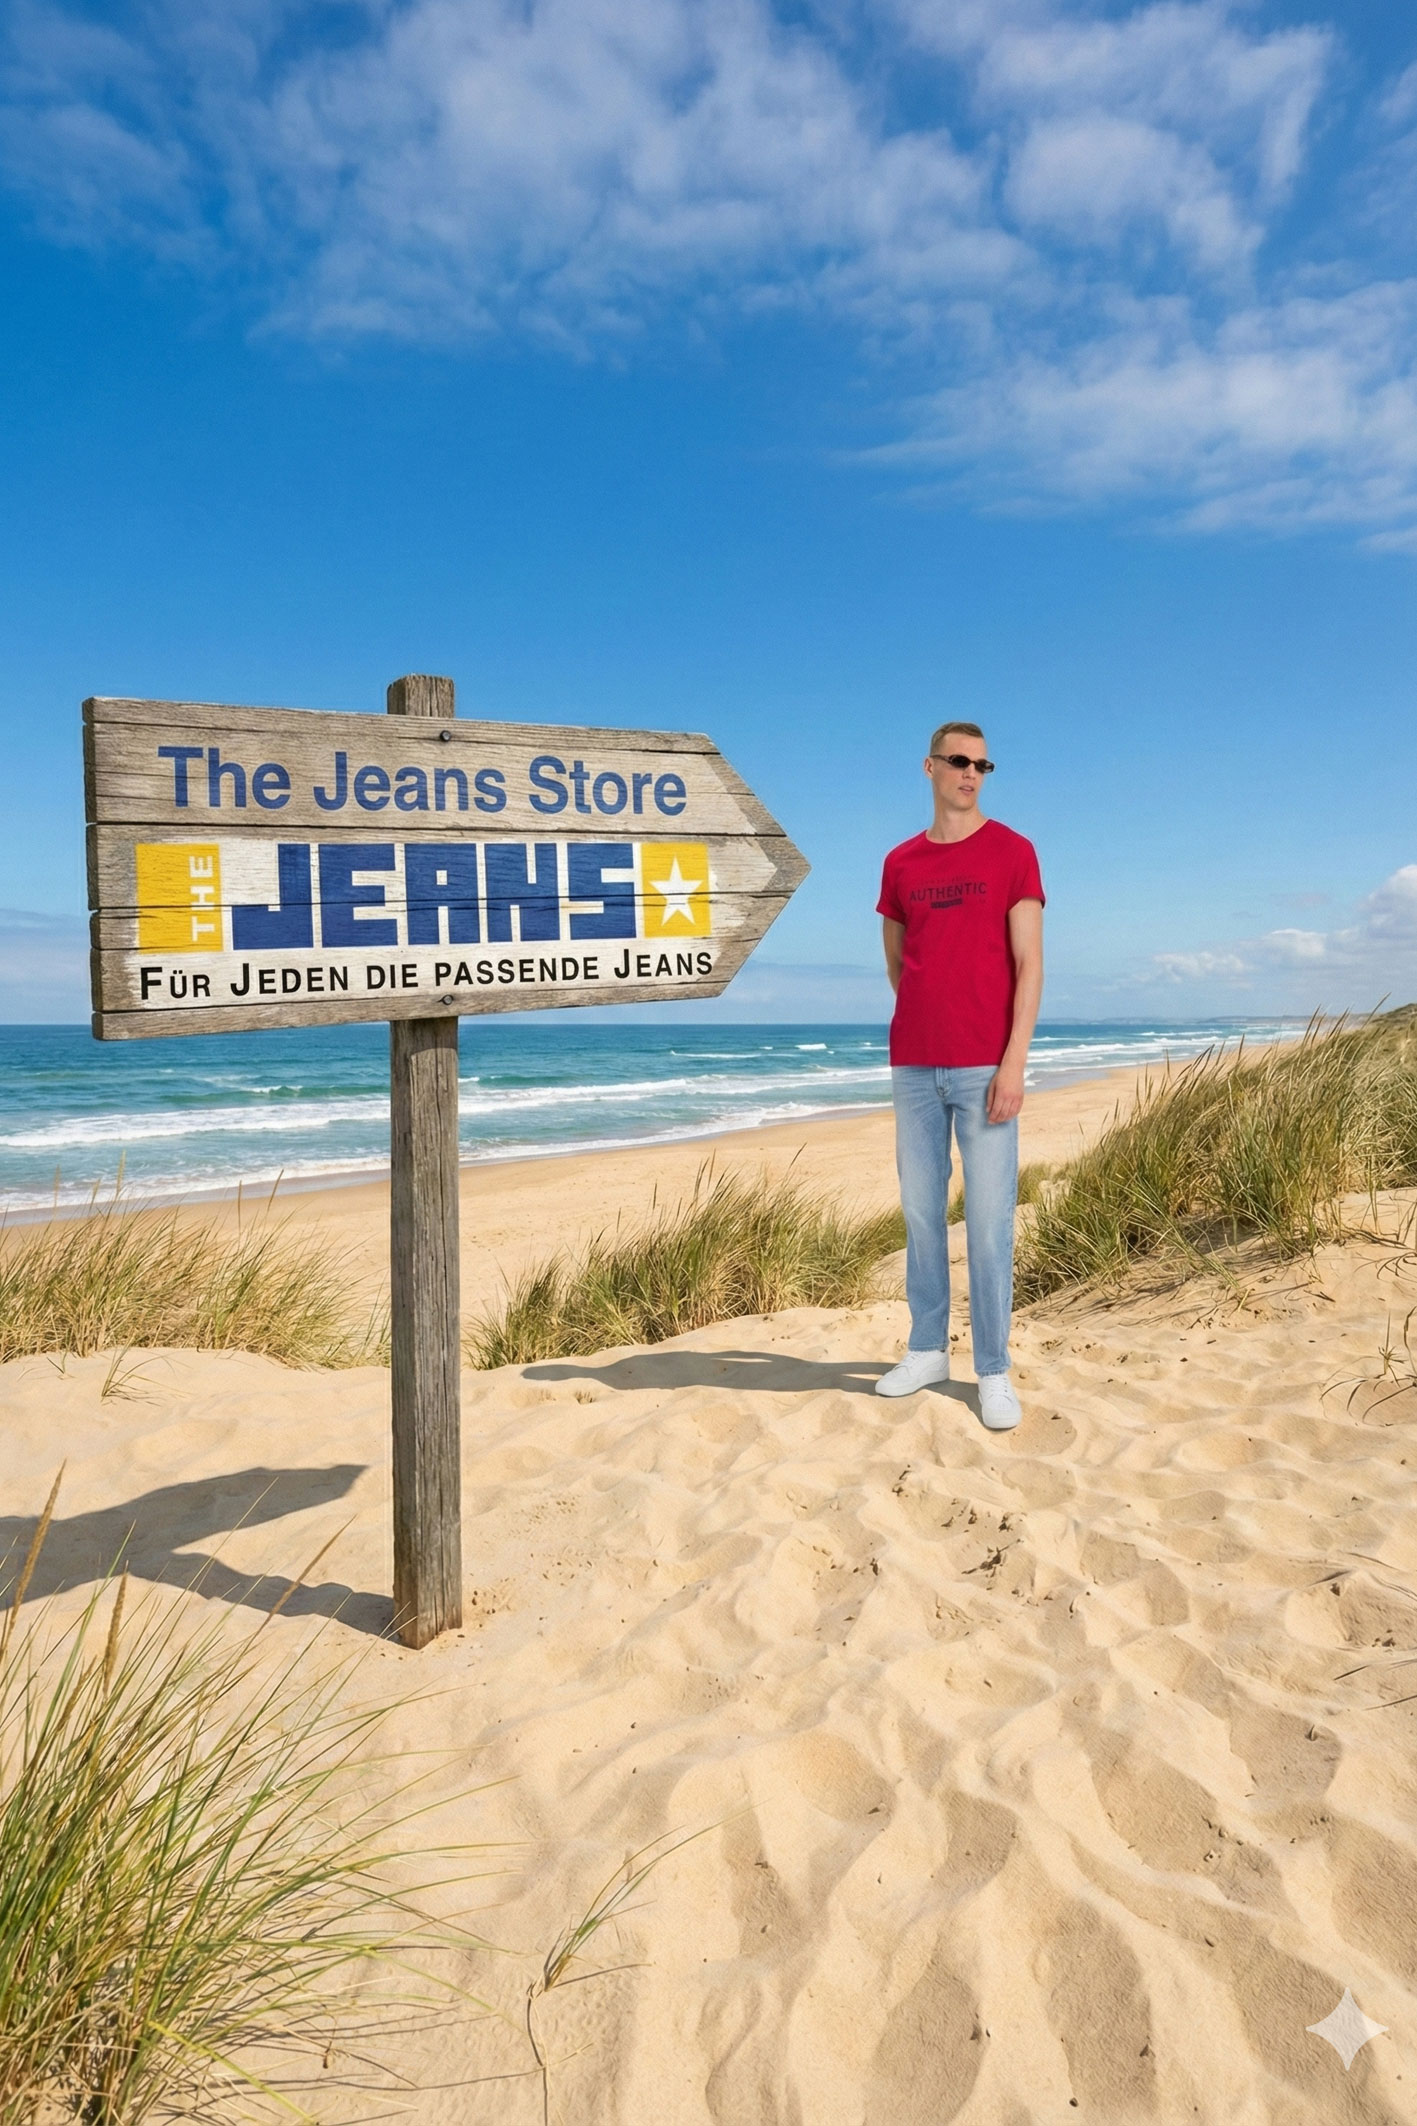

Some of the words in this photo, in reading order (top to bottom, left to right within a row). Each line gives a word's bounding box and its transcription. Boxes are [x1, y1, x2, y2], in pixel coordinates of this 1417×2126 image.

[158, 746, 290, 809] The
[313, 752, 507, 812] Jeans
[529, 755, 686, 816] Store
[188, 855, 216, 941] THE
[231, 843, 637, 950] JEANS
[909, 881, 987, 902] AUTHENTIC
